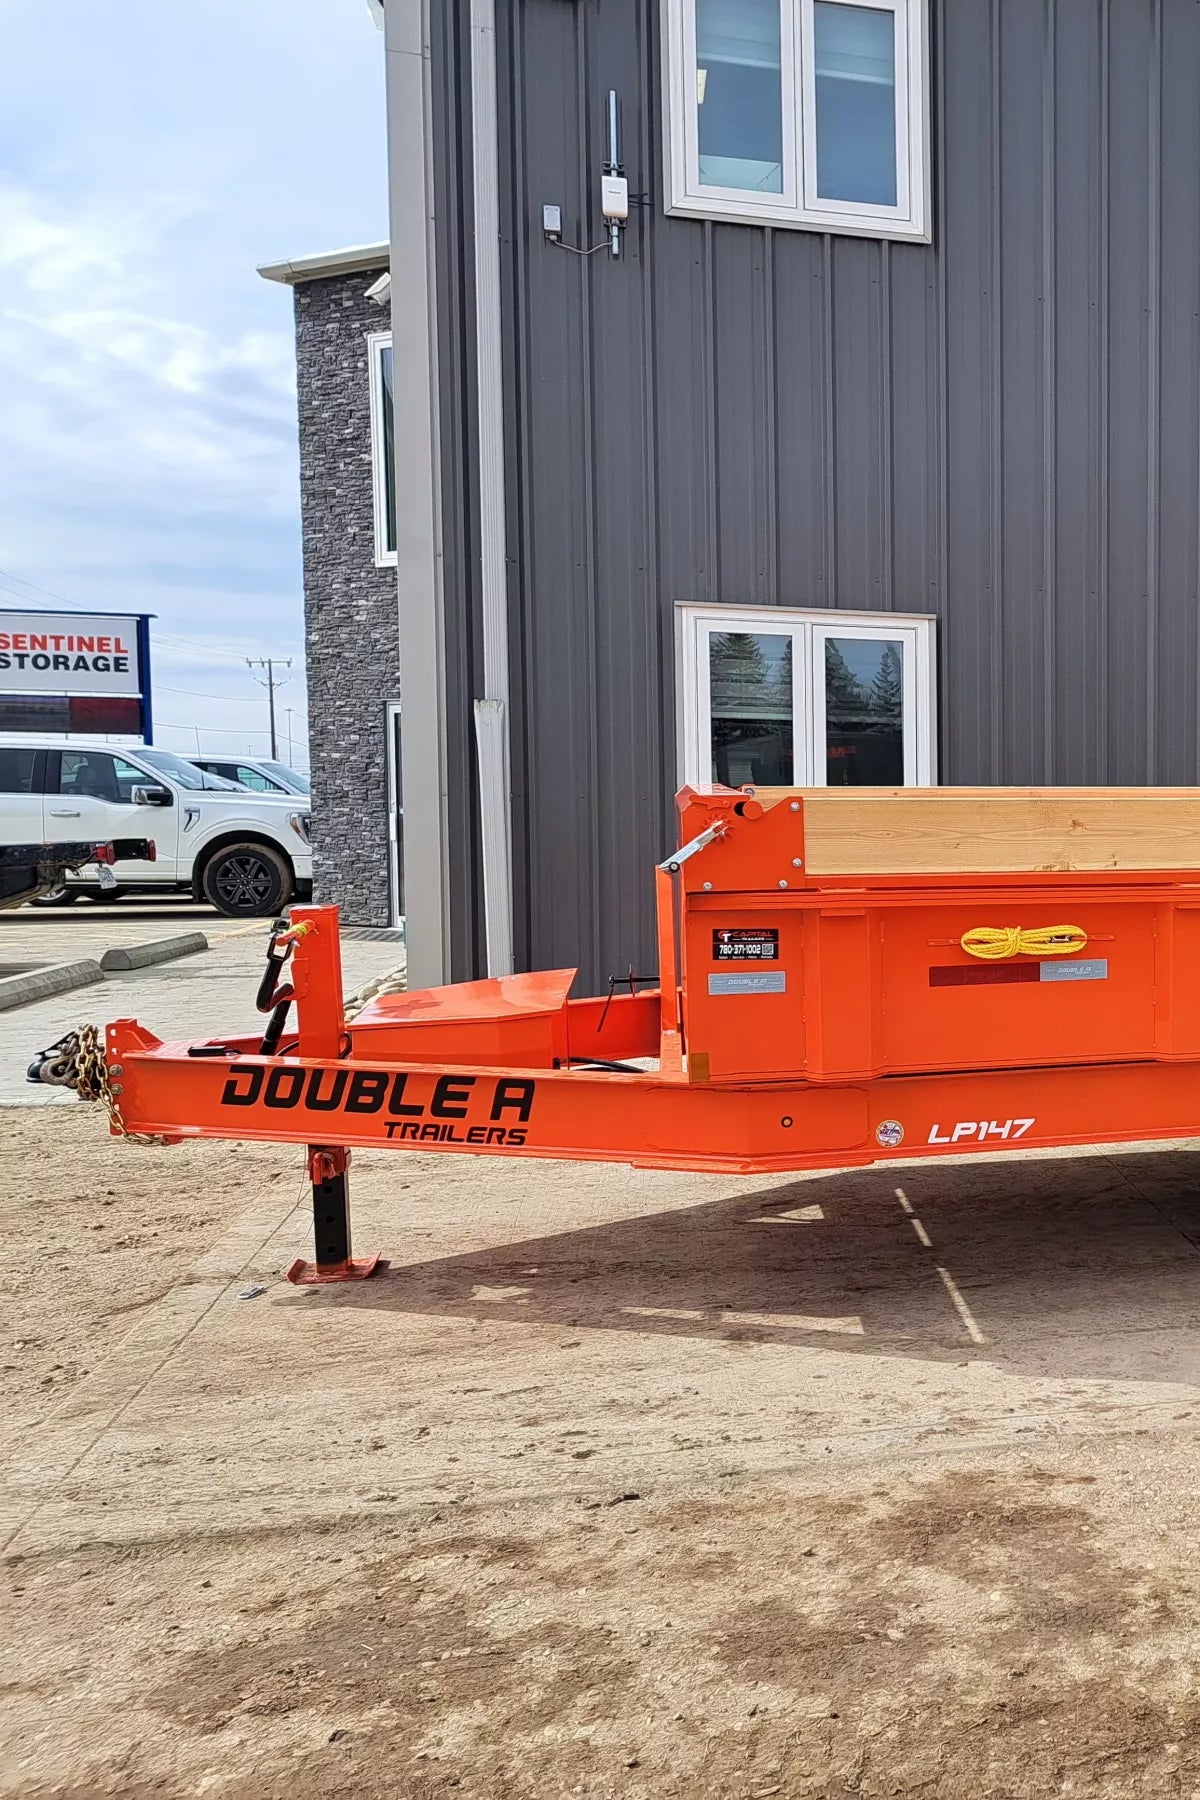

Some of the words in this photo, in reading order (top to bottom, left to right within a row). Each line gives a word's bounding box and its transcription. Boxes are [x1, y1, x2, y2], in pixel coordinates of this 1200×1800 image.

[0, 633, 128, 653] SENTINEL
[0, 653, 129, 673] STORAGE
[719, 944, 761, 955] 780-371-1002
[220, 1064, 476, 1119] DOUBLE
[489, 1078, 535, 1122] A
[384, 1121, 528, 1146] TRAILERS
[927, 1118, 1036, 1144] LP147
